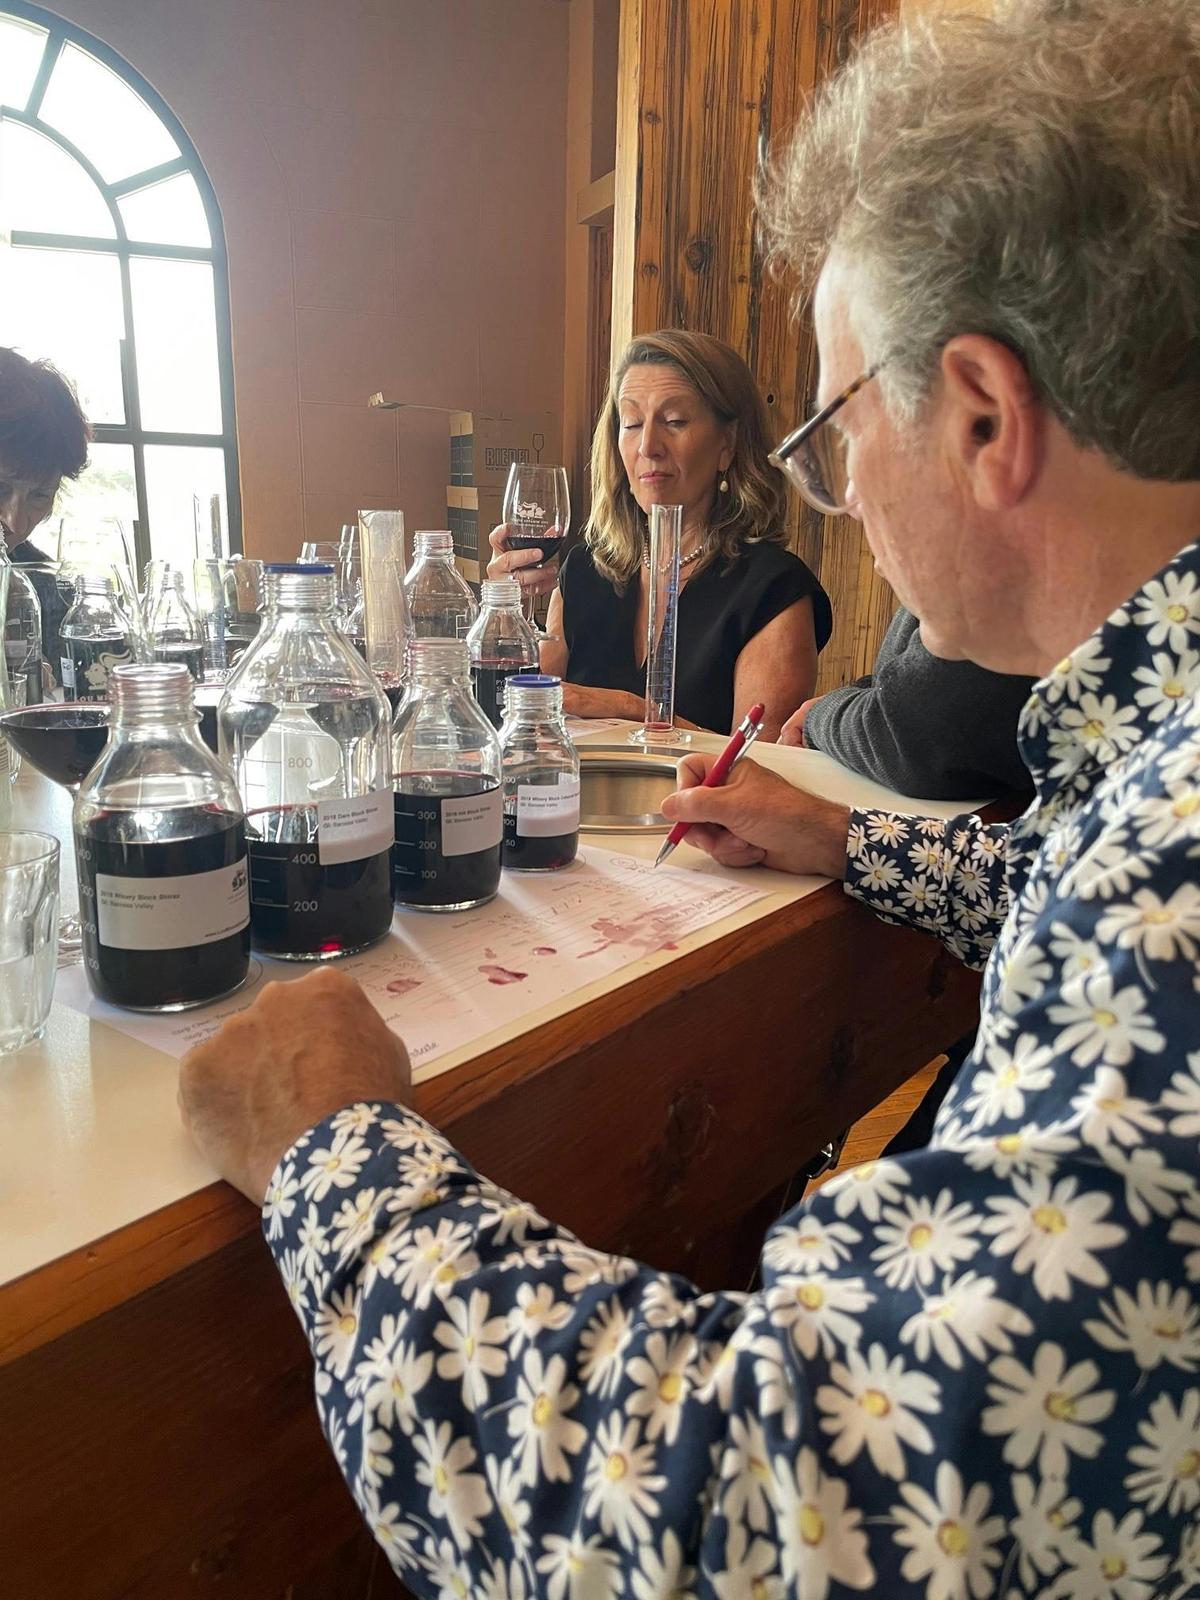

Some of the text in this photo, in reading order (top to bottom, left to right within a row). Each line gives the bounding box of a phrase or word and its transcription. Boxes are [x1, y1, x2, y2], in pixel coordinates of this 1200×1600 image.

[485, 448, 529, 467] RIEDEL
[288, 757, 313, 769] 800
[417, 811, 437, 820] 300
[418, 840, 437, 850] 200
[291, 853, 317, 865] 400
[421, 870, 437, 879] 100
[294, 900, 318, 912] 200
